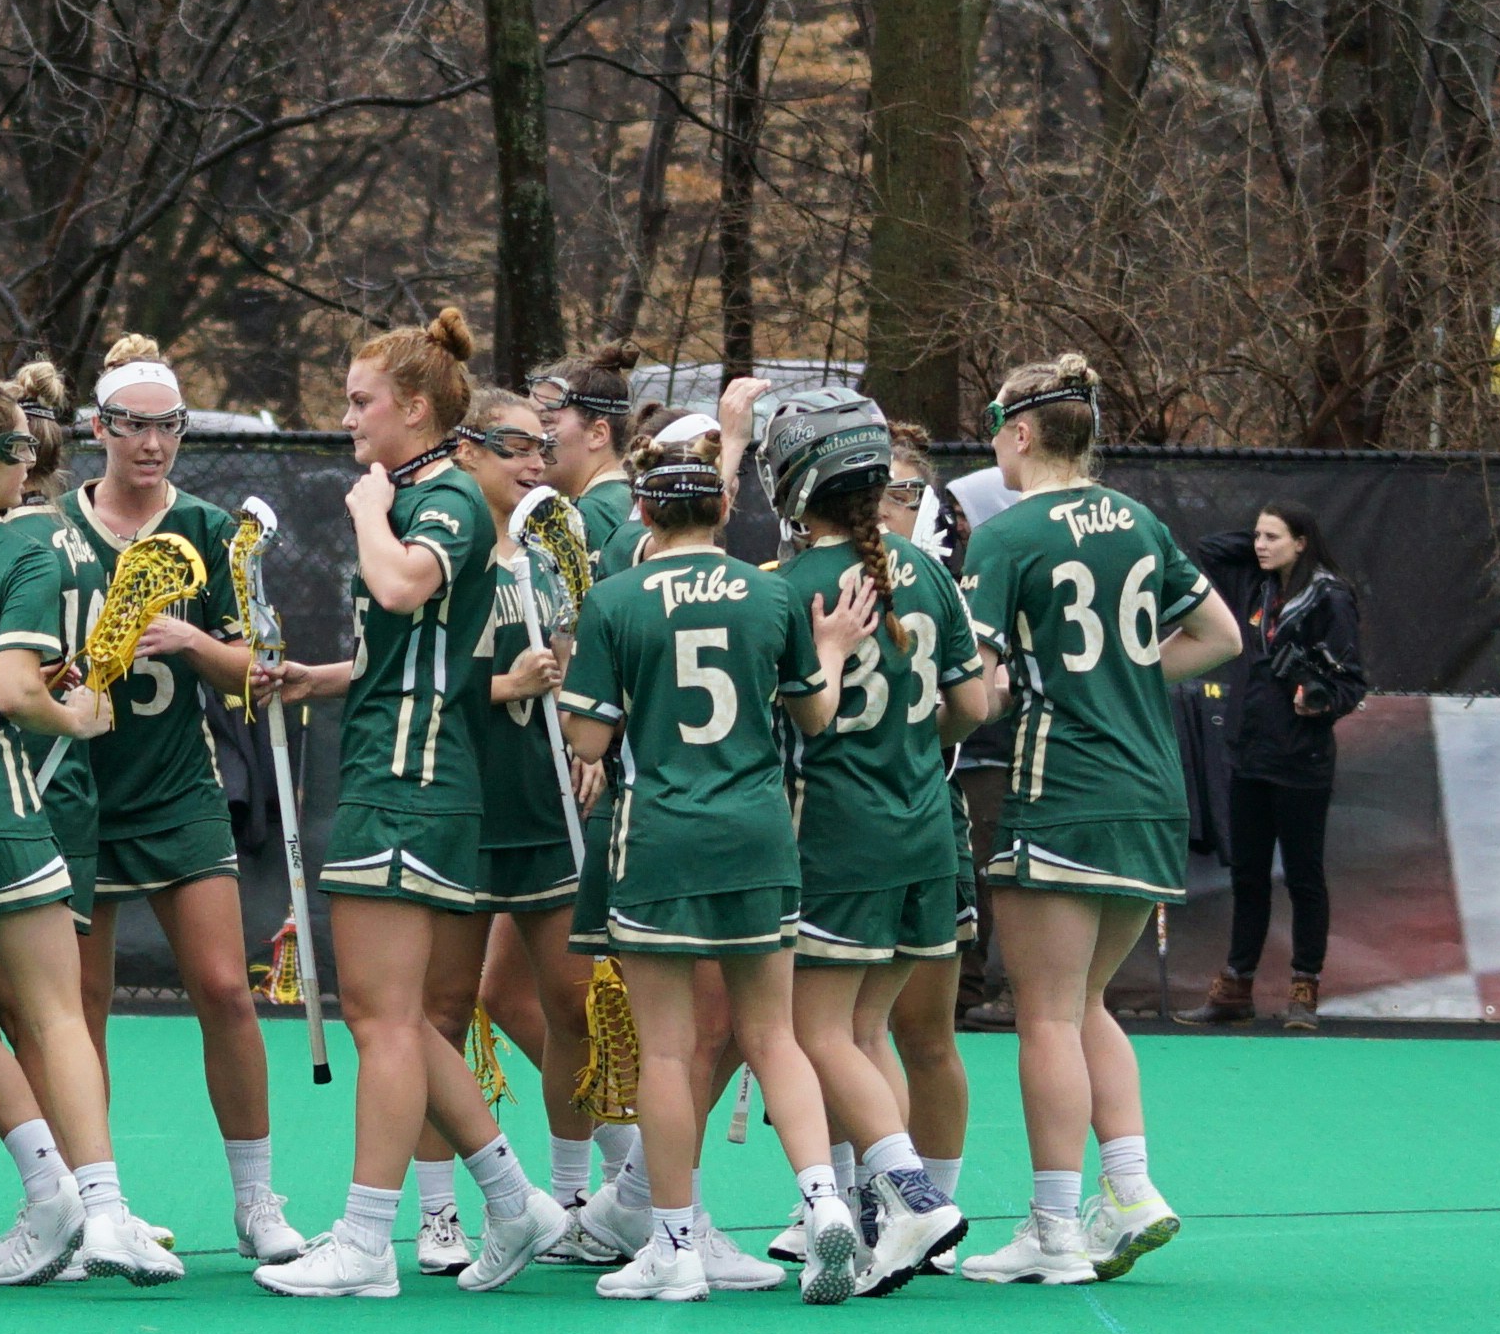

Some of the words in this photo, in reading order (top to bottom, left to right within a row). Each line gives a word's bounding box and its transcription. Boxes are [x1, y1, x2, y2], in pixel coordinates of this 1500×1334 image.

[1050, 496, 1135, 548] Tribe
[643, 564, 750, 618] Tribe
[1052, 555, 1162, 673] 36
[675, 627, 738, 745] 5
[1203, 683, 1221, 698] 14
[286, 833, 302, 870] Tribe
